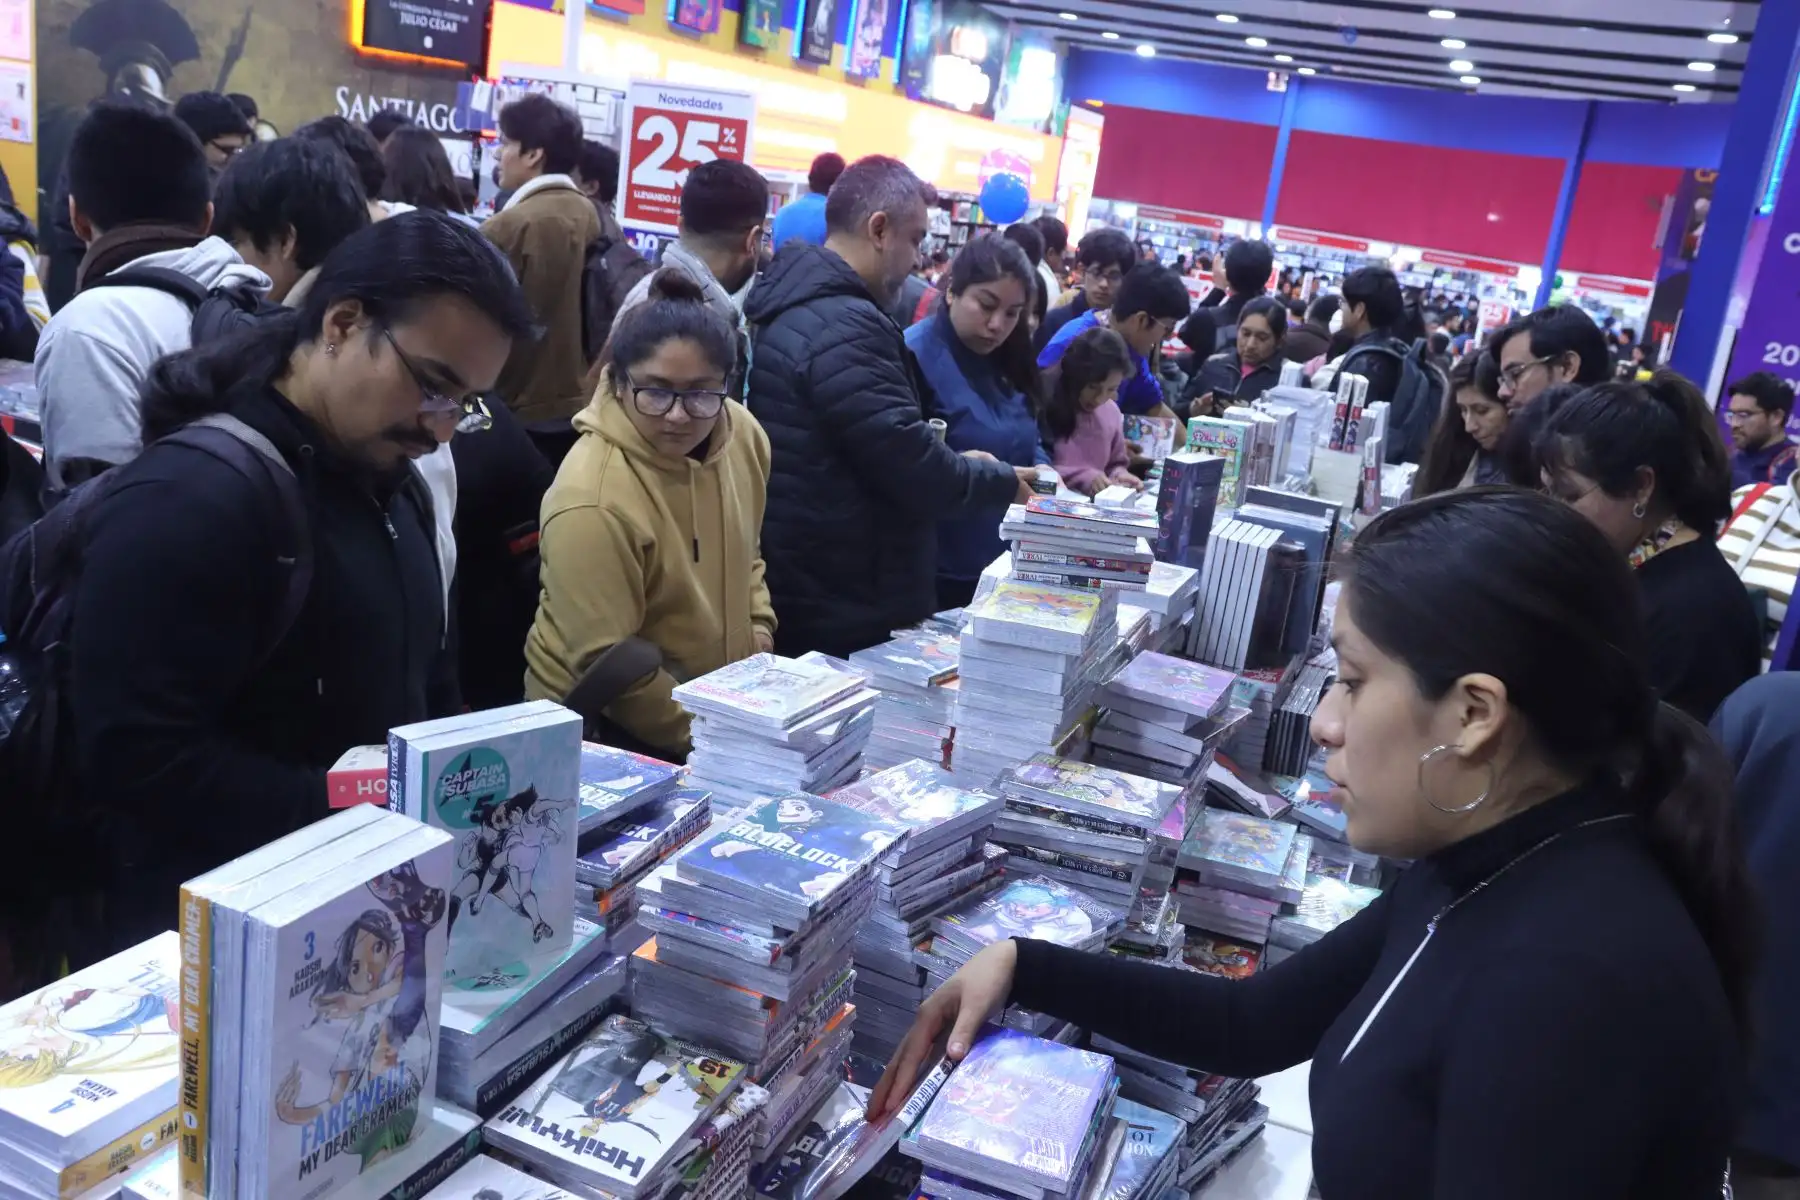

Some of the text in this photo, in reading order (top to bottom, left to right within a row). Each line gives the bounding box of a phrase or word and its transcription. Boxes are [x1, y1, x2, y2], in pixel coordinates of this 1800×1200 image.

[400, 12, 426, 27] JULIO
[658, 93, 724, 111] Novedades
[722, 127, 737, 144] %
[634, 190, 672, 203] LLEVANDO
[438, 773, 507, 797] TSUBASA
[441, 763, 504, 786] CAPTAIN
[728, 823, 857, 873] BLUELOCK
[304, 930, 315, 961] 3
[184, 969, 199, 1007] DEAR
[184, 1007, 199, 1032] MY
[697, 1057, 731, 1079] 19
[48, 1098, 75, 1114] 4
[299, 1150, 320, 1181] MY
[324, 1127, 358, 1169] DEAR
